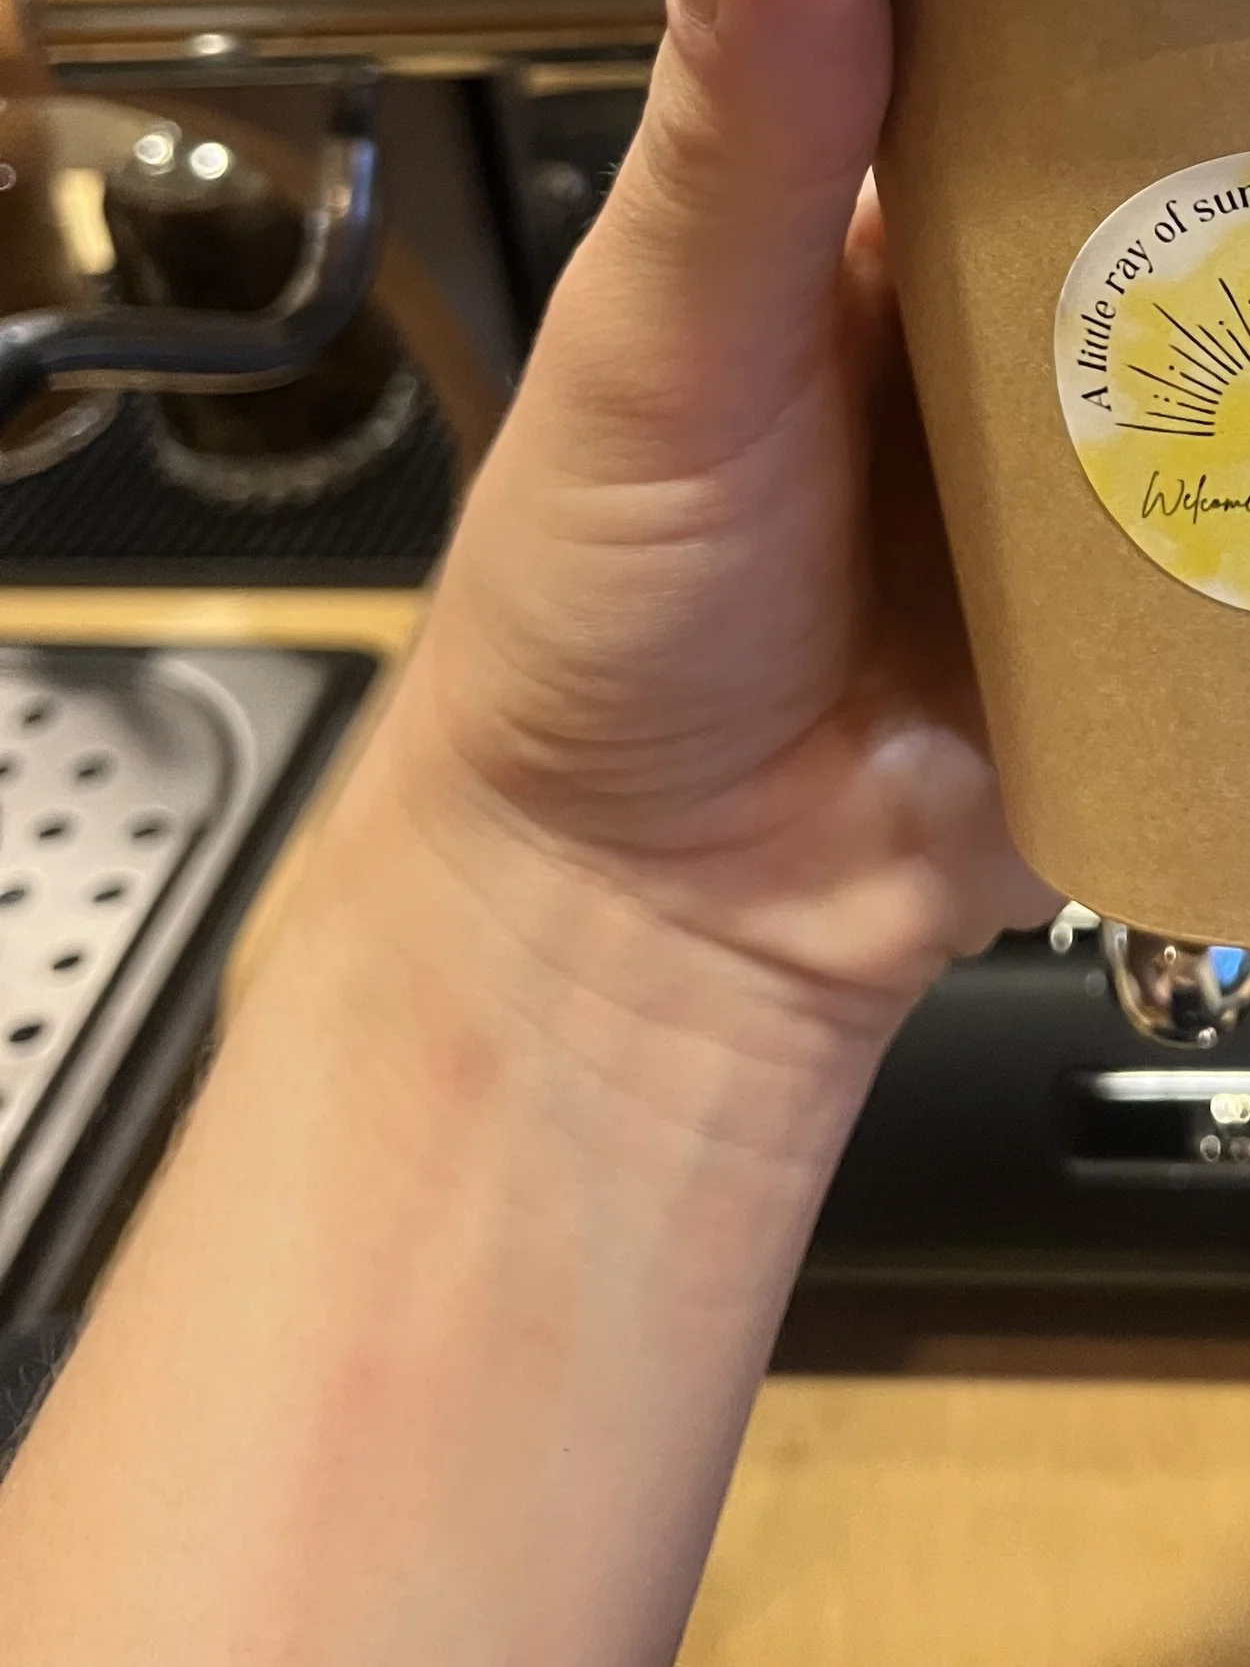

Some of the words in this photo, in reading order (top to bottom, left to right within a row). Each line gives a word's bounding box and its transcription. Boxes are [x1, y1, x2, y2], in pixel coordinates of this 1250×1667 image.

[1153, 200, 1188, 245] of
[1105, 239, 1154, 295] ray
[1076, 299, 1117, 373] little
[1081, 385, 1112, 412] A
